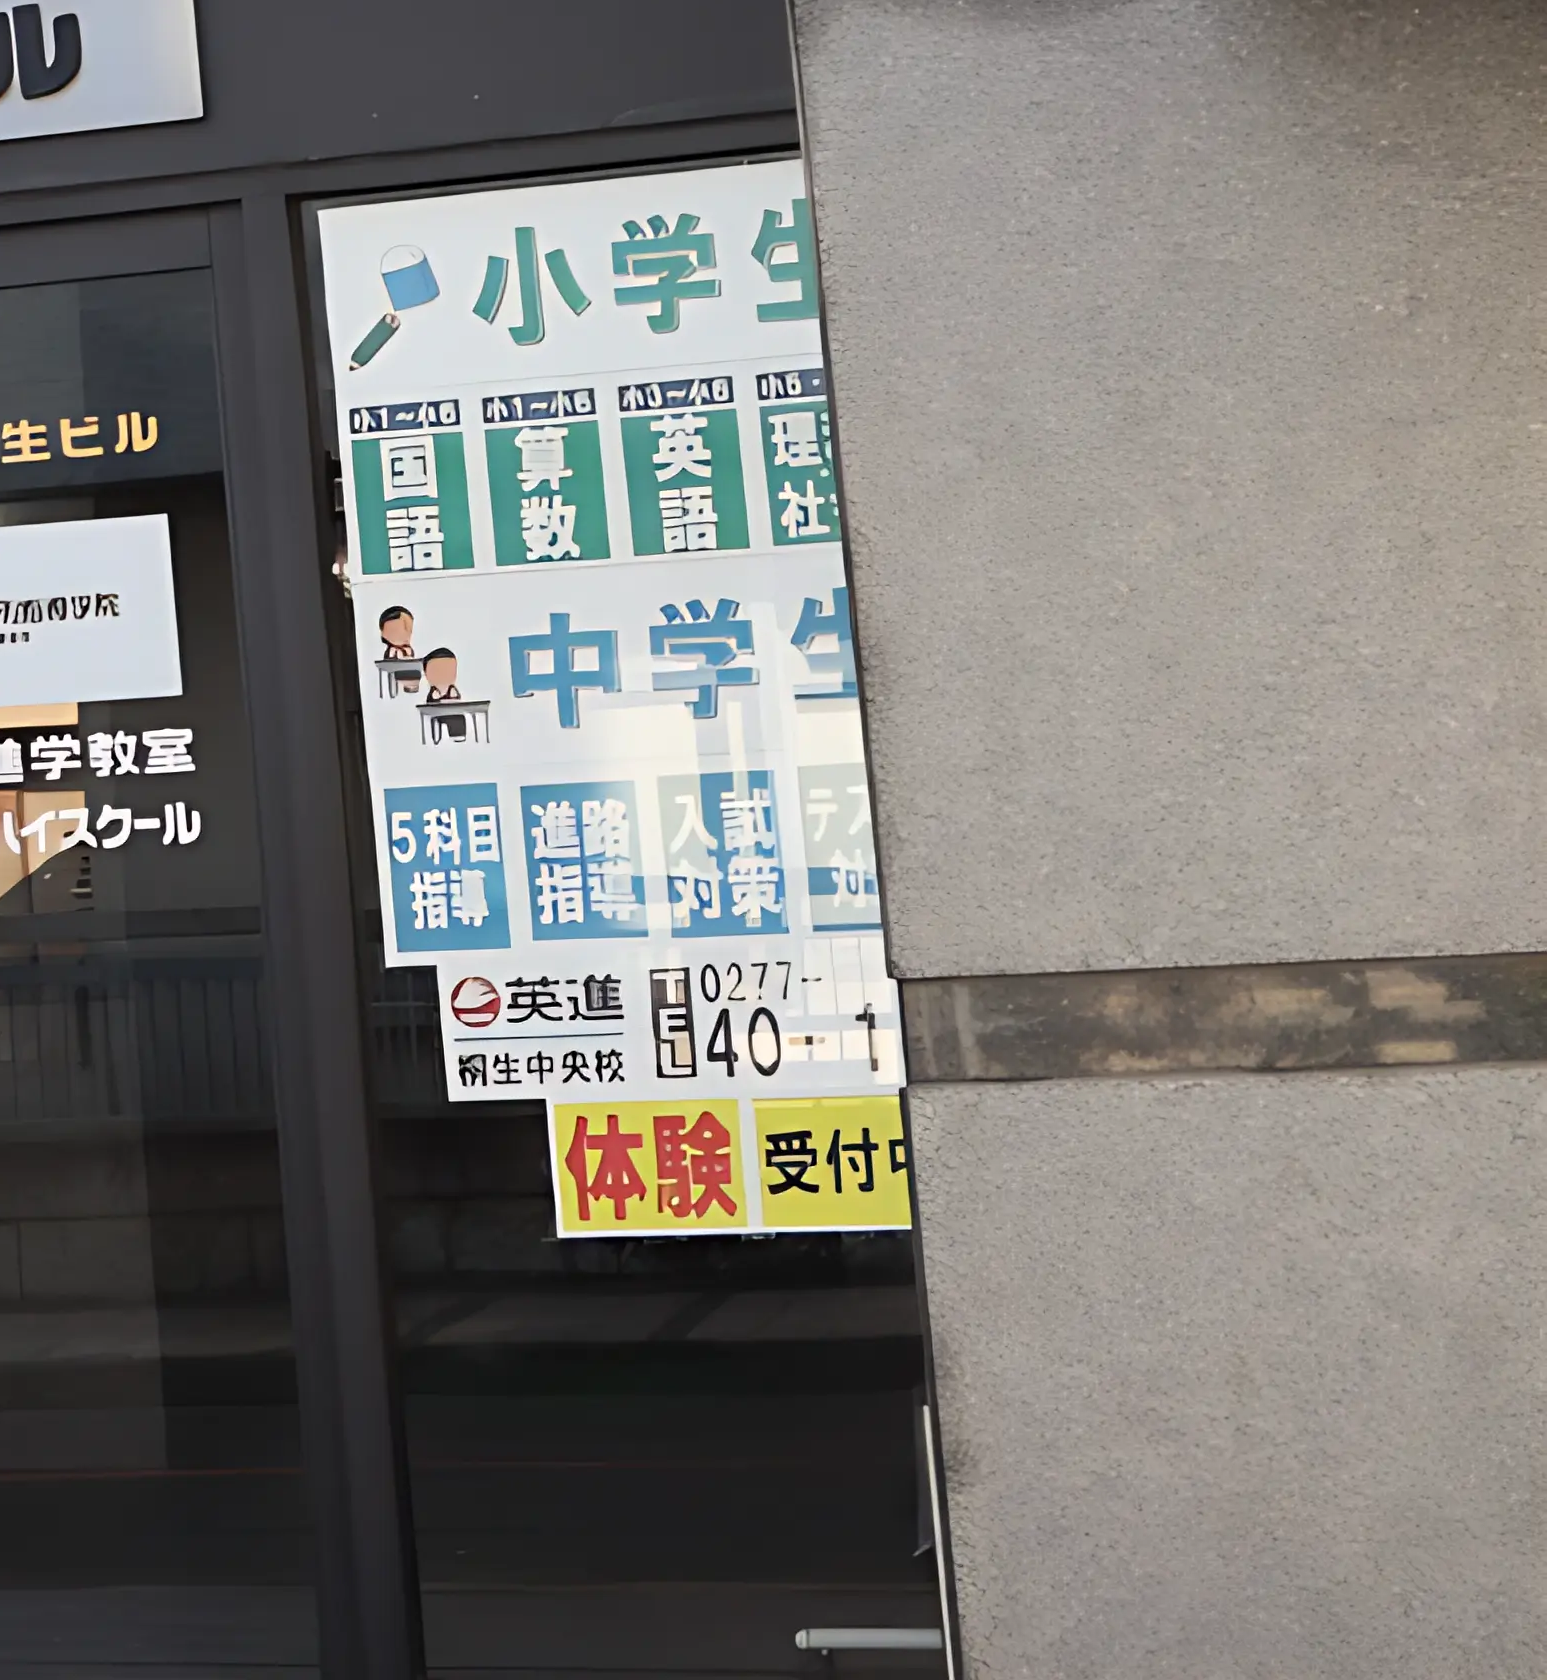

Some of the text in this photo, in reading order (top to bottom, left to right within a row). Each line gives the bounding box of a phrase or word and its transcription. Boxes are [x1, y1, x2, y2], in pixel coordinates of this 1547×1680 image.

[472, 198, 821, 346] 小学生
[380, 435, 445, 572] 国語
[515, 426, 581, 561] 算数
[651, 414, 718, 552] 英語
[509, 586, 859, 729] 中学生
[391, 806, 500, 865] 5科目
[506, 974, 625, 1022] 英進
[653, 968, 697, 1077] TEL
[565, 1111, 737, 1221] 体験
